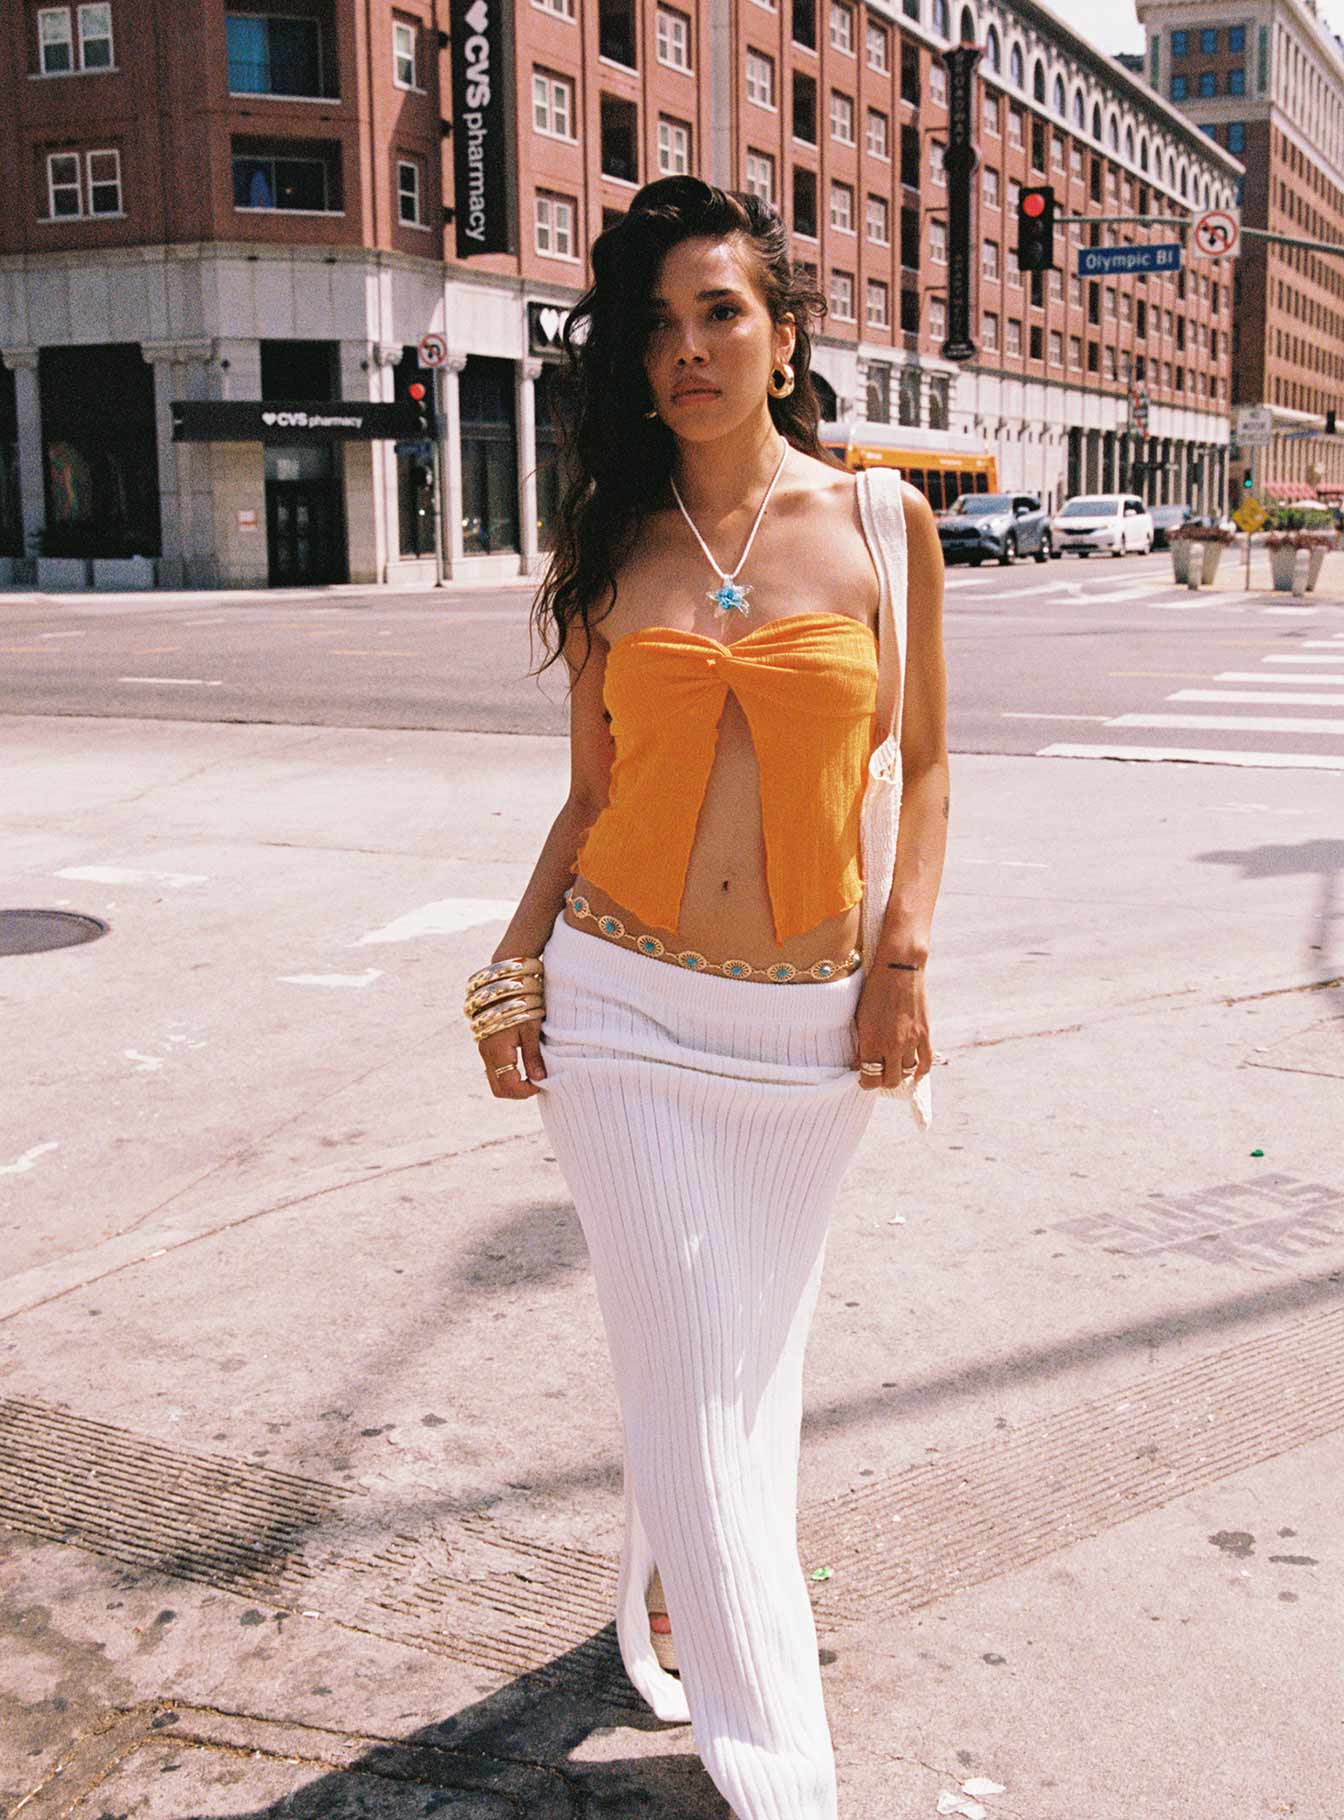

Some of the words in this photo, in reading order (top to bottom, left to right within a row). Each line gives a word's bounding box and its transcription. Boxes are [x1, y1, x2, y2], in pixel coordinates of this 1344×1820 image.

[465, 35, 490, 108] CVS
[463, 112, 488, 242] pharmacy
[1086, 253, 1151, 272] Olympic
[1156, 249, 1174, 265] Bl
[277, 412, 308, 427] CVS
[309, 416, 363, 428] pharmacy
